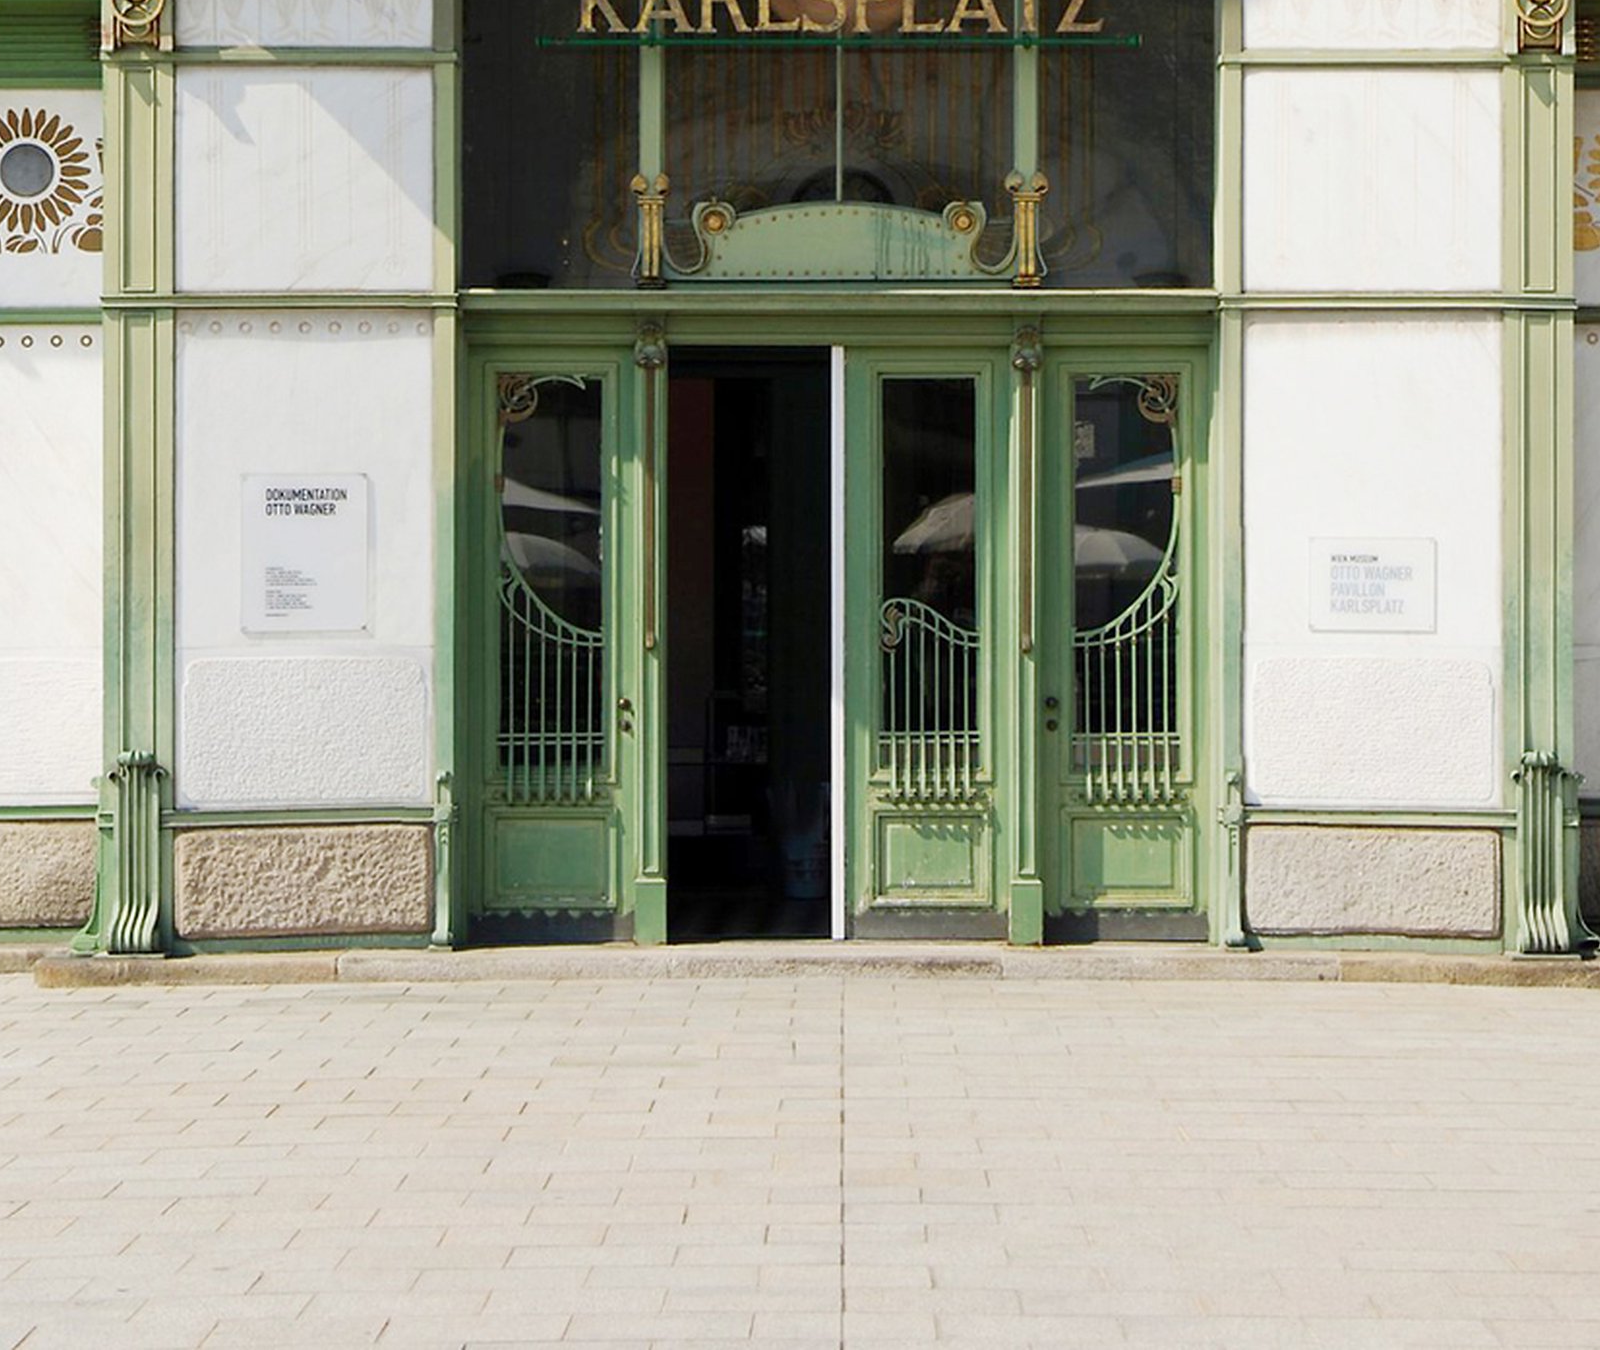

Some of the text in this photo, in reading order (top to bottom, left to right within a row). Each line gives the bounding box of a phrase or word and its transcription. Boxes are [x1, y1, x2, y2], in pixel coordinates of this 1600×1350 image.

[265, 488, 348, 502] DOKUMENTATION
[265, 503, 336, 516] OTTO WAGNER
[1330, 565, 1413, 581] OTTO WAGNER
[1330, 582, 1386, 597] PAVILLON
[1330, 598, 1405, 614] KARLSPLATZ
